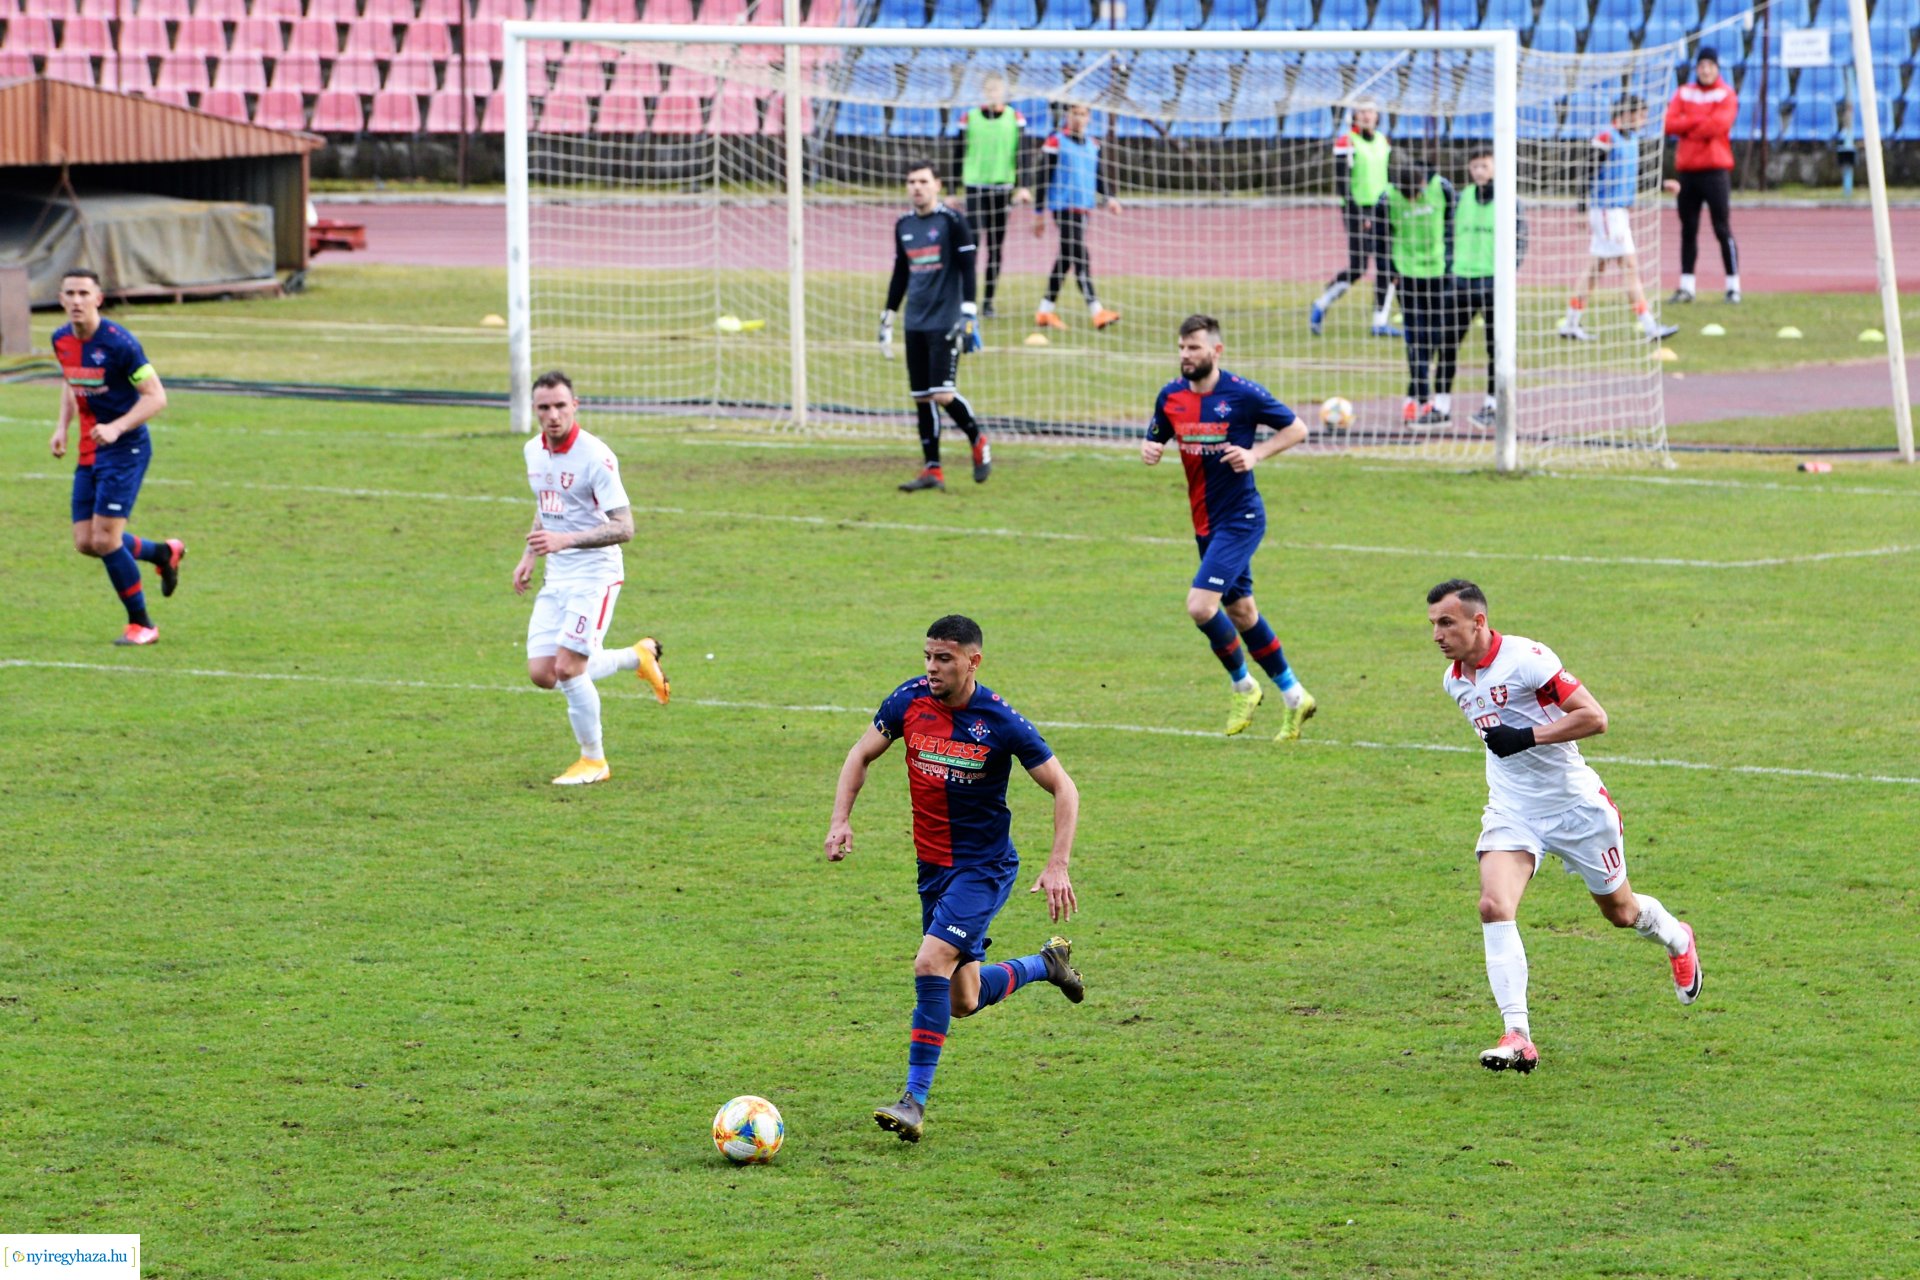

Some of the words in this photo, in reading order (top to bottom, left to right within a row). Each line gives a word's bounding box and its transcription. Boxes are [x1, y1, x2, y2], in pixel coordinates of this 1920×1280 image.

[575, 615, 587, 634] 6
[909, 732, 991, 762] REVESZ
[1601, 846, 1621, 874] 10
[946, 925, 967, 939] JAKO
